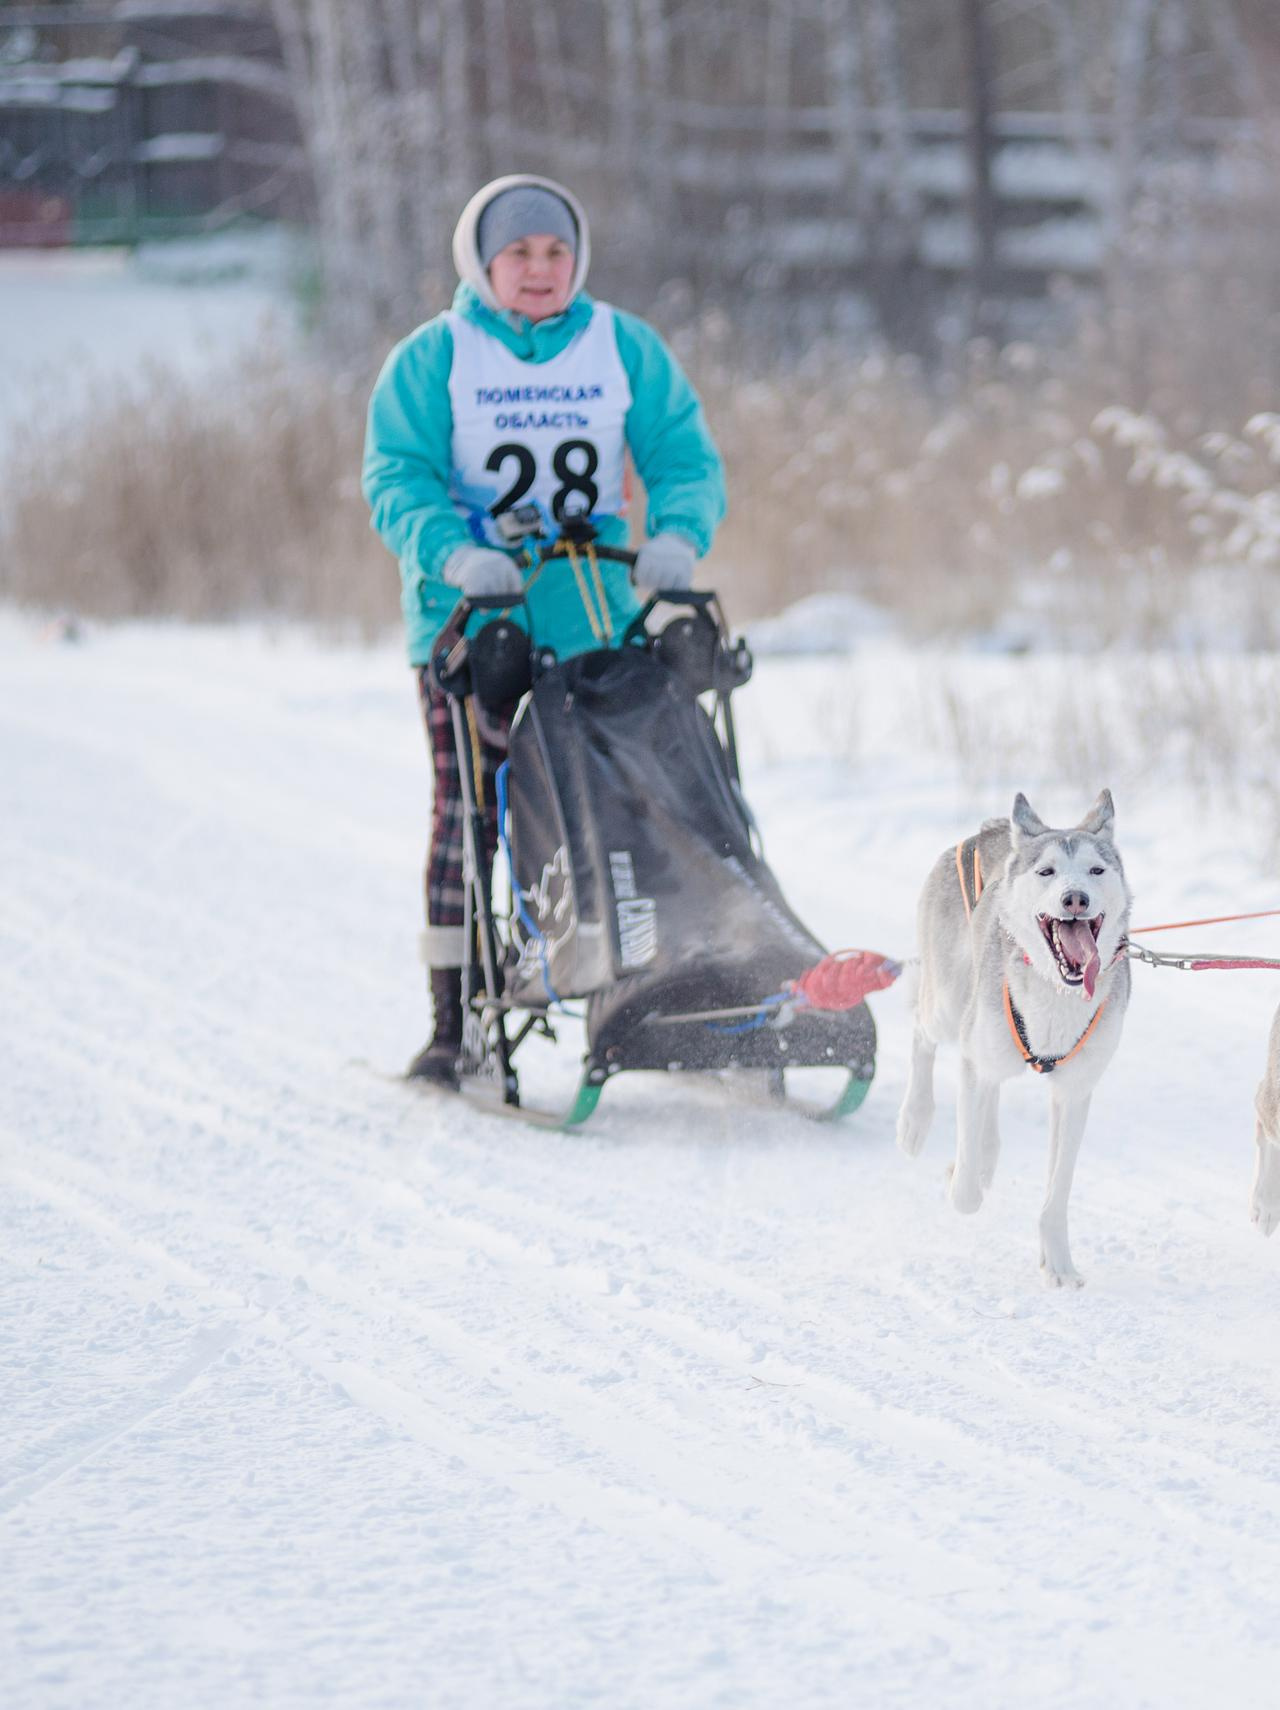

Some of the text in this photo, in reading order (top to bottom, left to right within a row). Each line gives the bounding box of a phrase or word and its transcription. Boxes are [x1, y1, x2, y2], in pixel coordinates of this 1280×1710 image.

[475, 384, 603, 404] ТЮМЕНСКАЯ
[494, 411, 589, 429] ОБЛАСТЬ
[485, 439, 599, 523] 28
